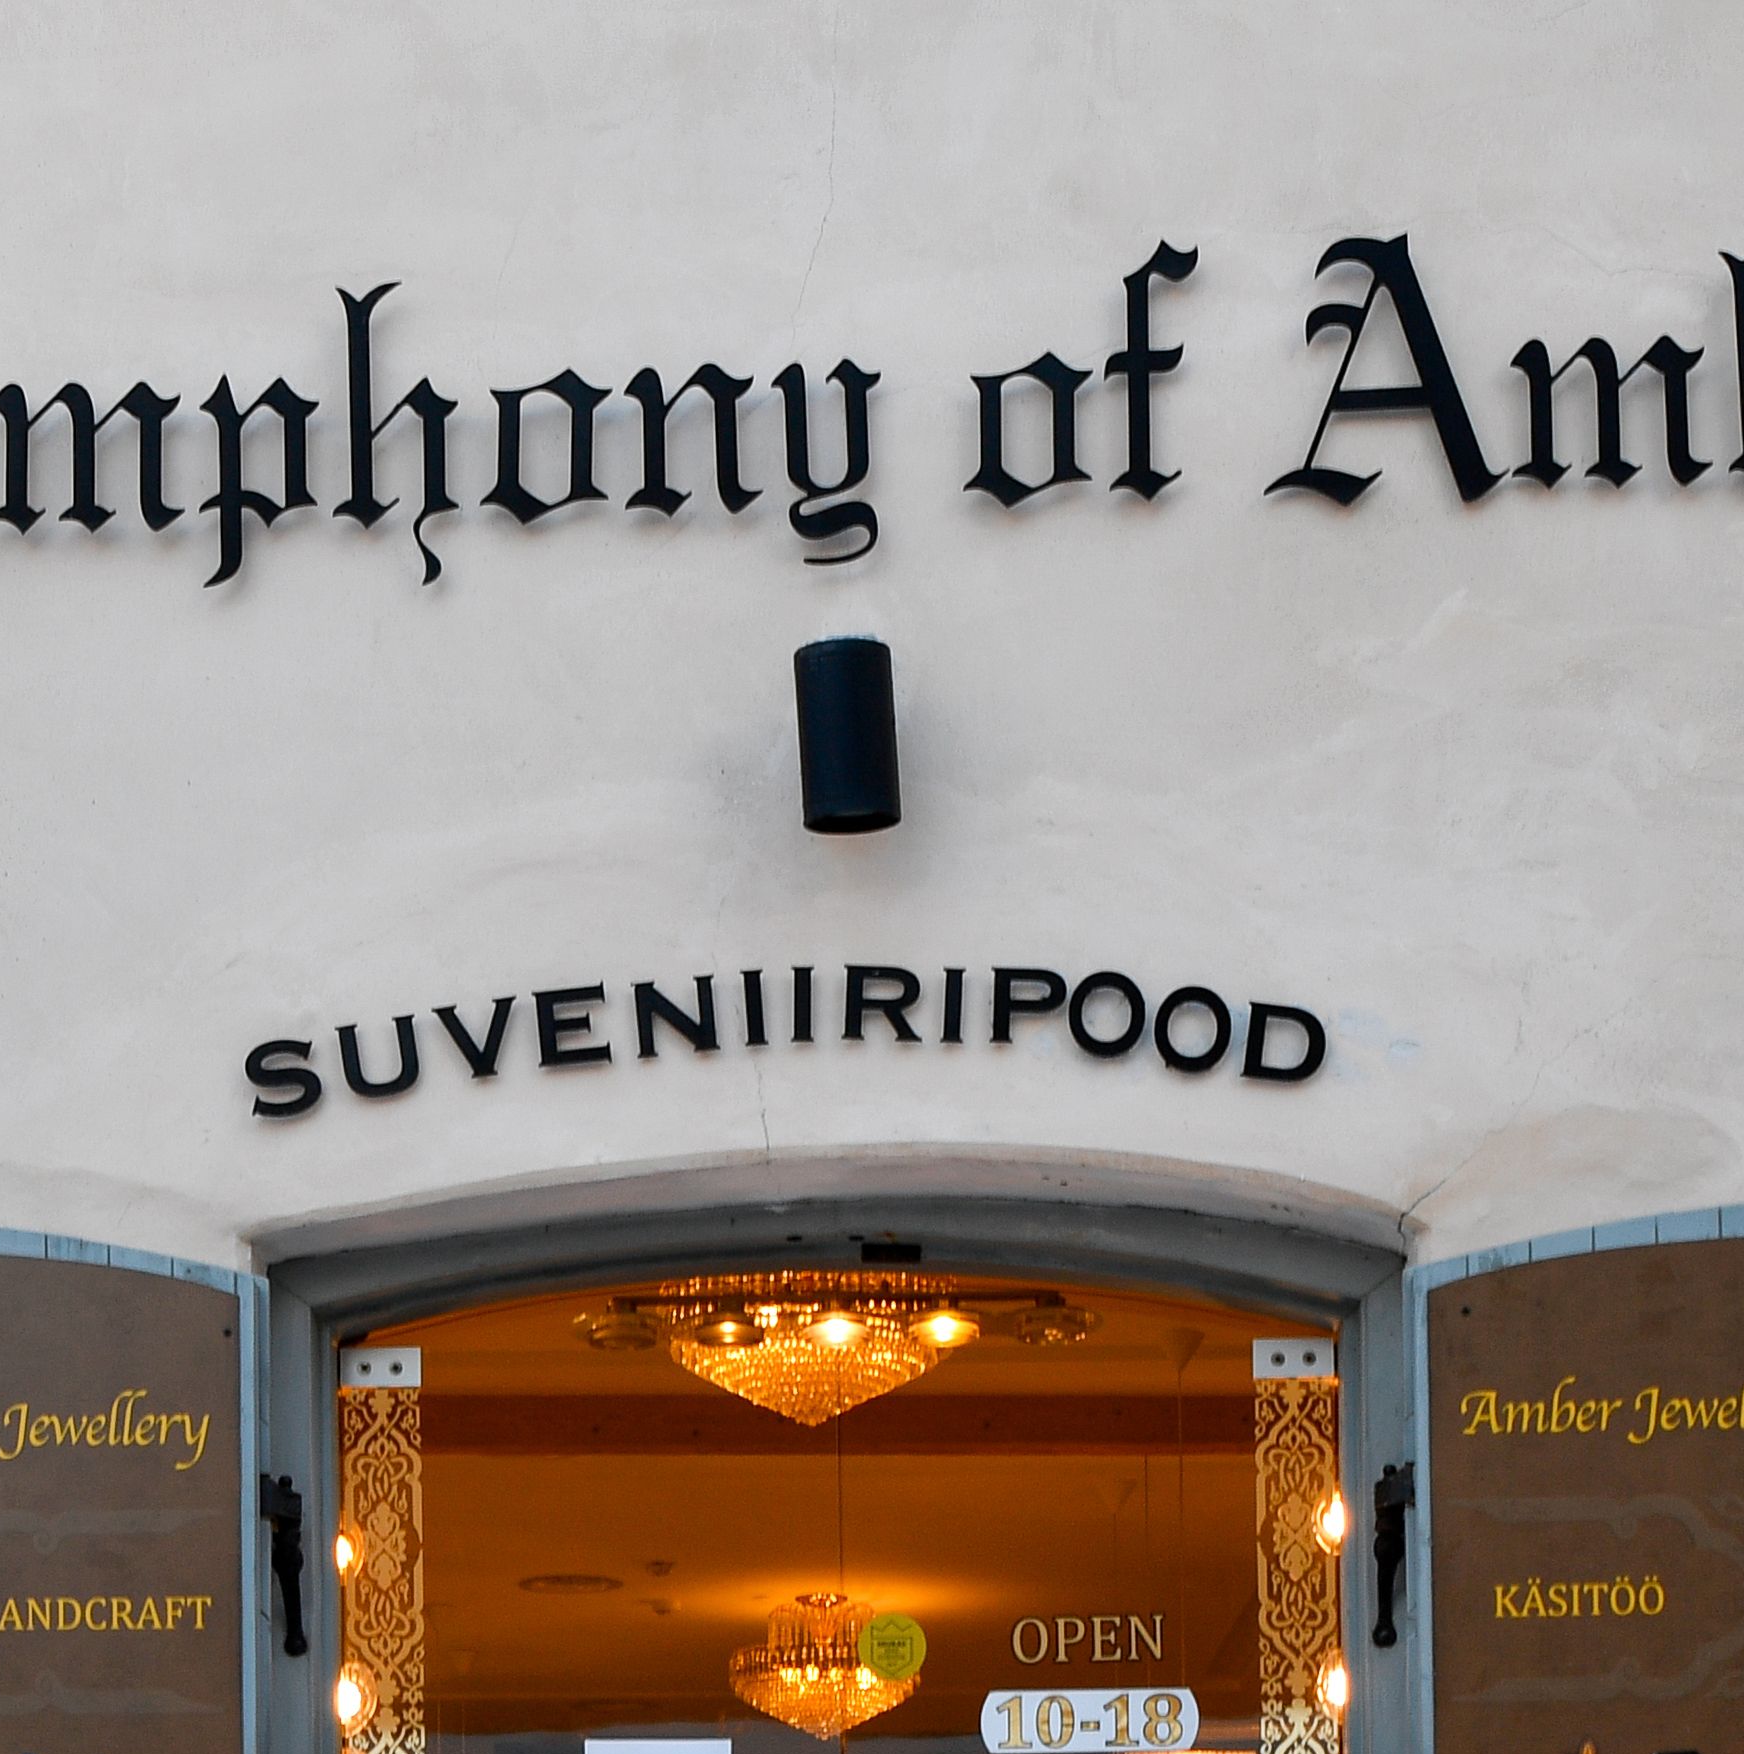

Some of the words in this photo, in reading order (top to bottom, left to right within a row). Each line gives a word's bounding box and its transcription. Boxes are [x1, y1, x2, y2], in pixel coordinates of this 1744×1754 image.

[963, 239, 1199, 508] of
[244, 964, 1327, 1119] SUVENIIRIPOOD
[1460, 1374, 1622, 1436] Amber
[1493, 1574, 1665, 1619] KÄSITÖÖ
[1012, 1613, 1164, 1664] OPEN
[995, 1692, 1184, 1750] 10-18
